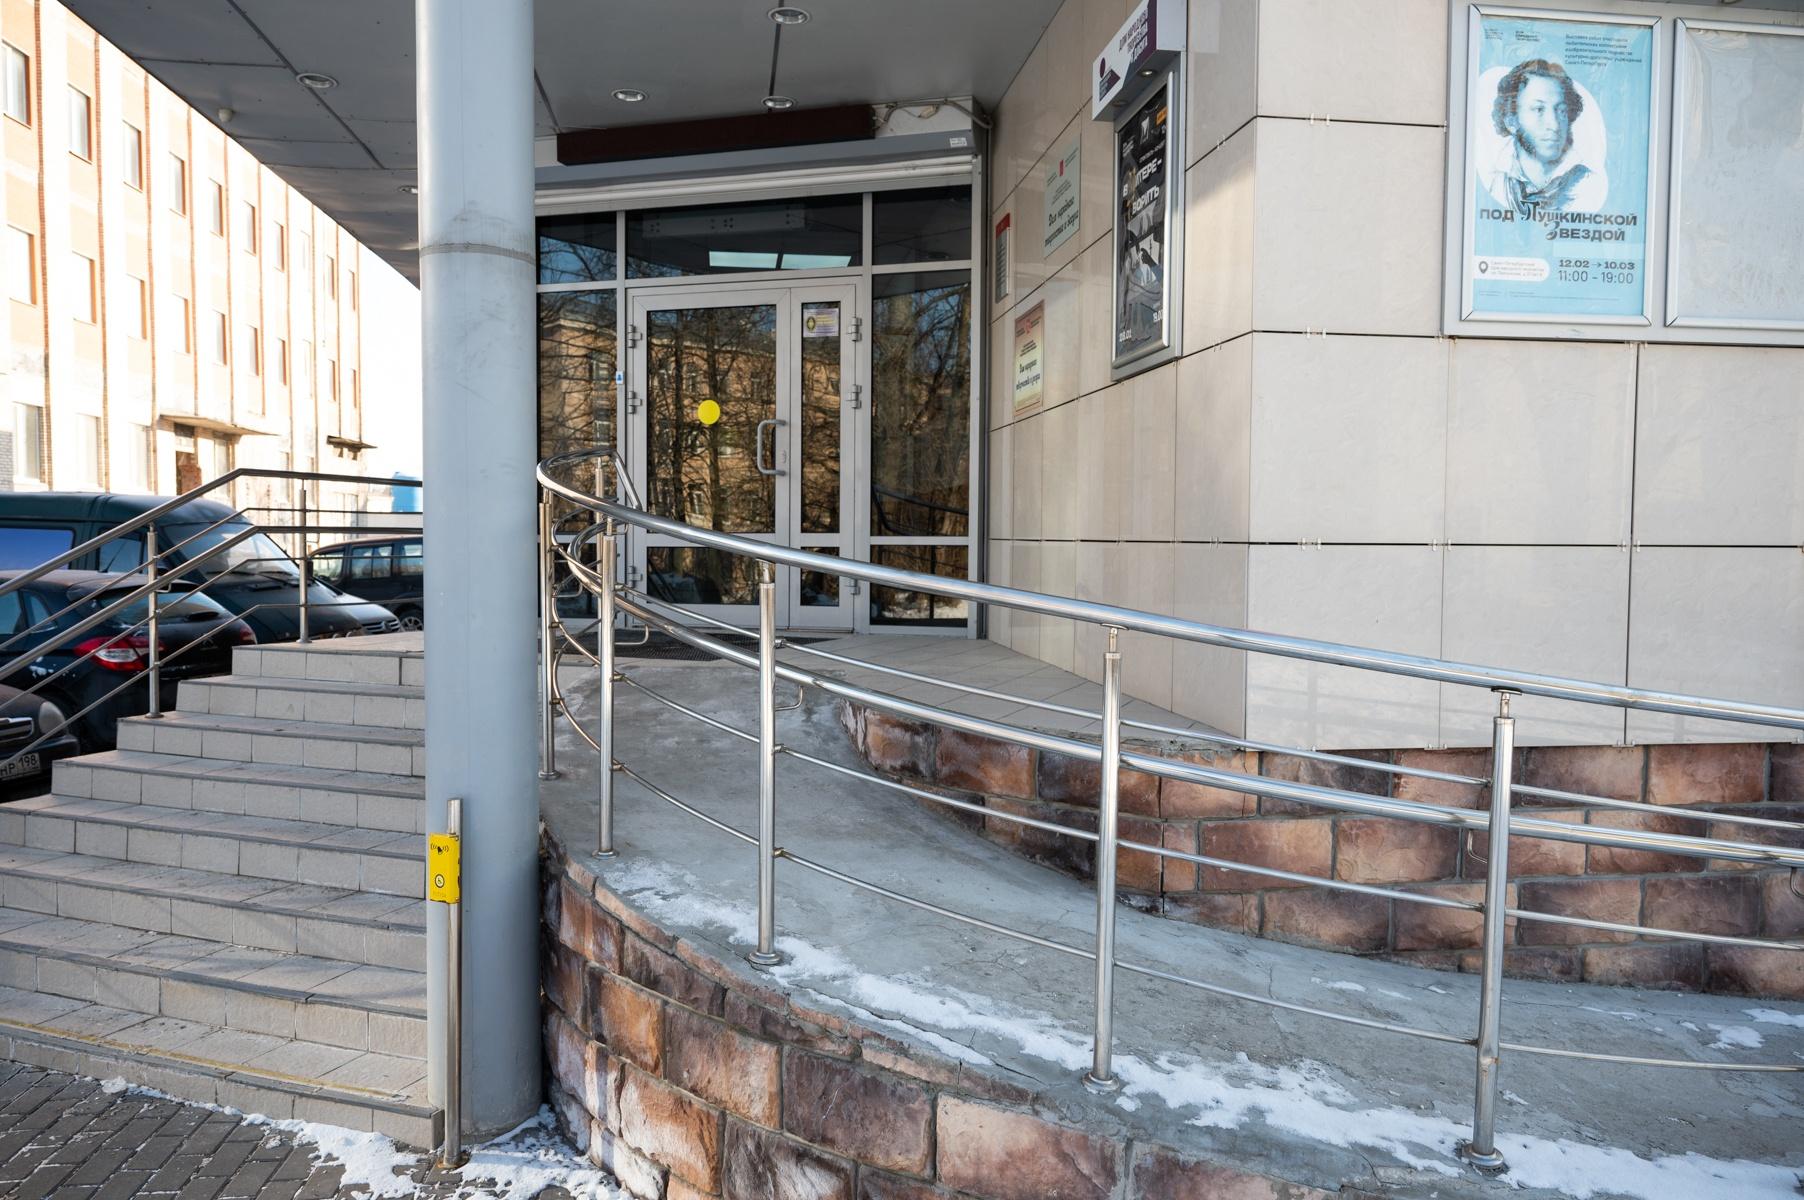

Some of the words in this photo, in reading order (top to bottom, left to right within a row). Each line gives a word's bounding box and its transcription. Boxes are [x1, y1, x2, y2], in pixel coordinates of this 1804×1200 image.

[1480, 209, 1515, 223] ПОД
[1544, 221, 1626, 242] ЗВЕЗДОЙ
[1559, 259, 1590, 268] 12.02
[1603, 261, 1635, 270] 10.03
[1559, 270, 1588, 282] 11:00
[1601, 271, 1634, 284] 19:00
[19, 755, 37, 767] 198
